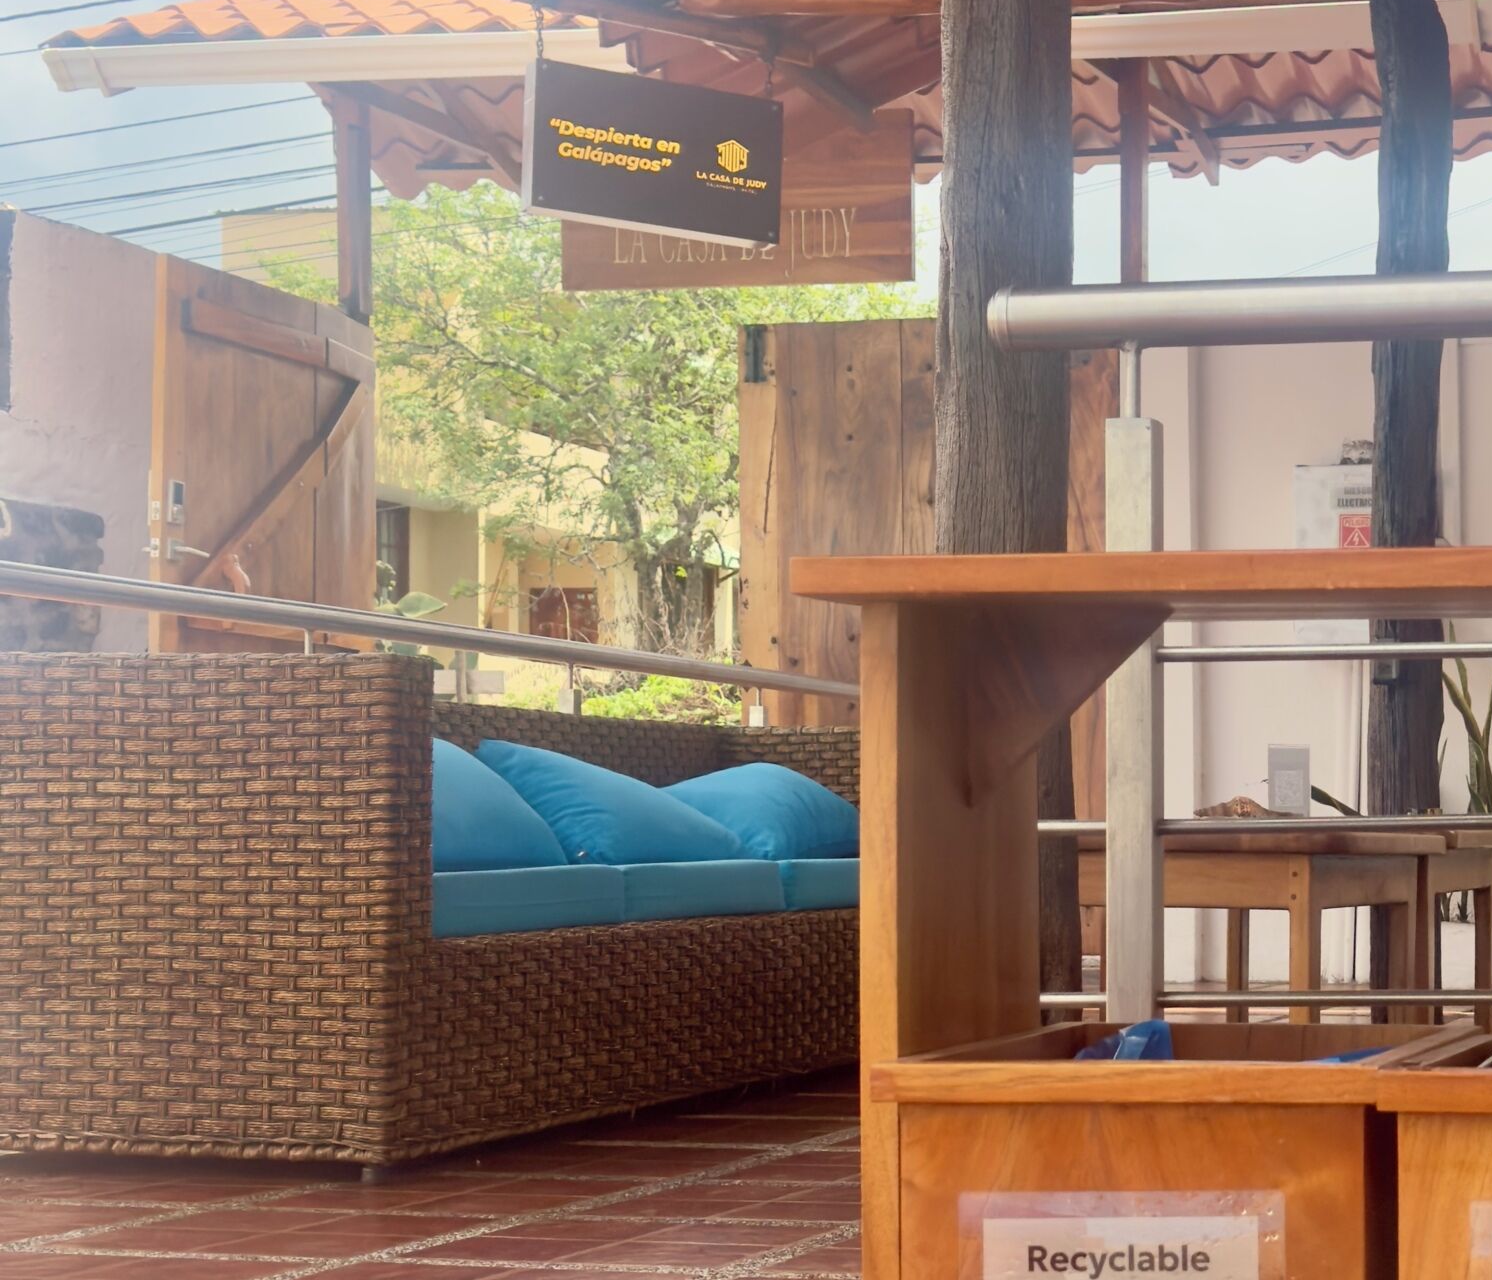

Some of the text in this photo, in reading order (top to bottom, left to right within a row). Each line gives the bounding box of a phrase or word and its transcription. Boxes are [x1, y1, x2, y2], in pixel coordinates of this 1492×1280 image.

[656, 139, 681, 155] en
[696, 171, 708, 180] LA
[709, 173, 730, 183] CASA
[732, 177, 744, 186] DE
[746, 179, 767, 190] JUDY
[784, 207, 858, 278] JUDY
[1027, 1245, 1211, 1279] Recyclable
